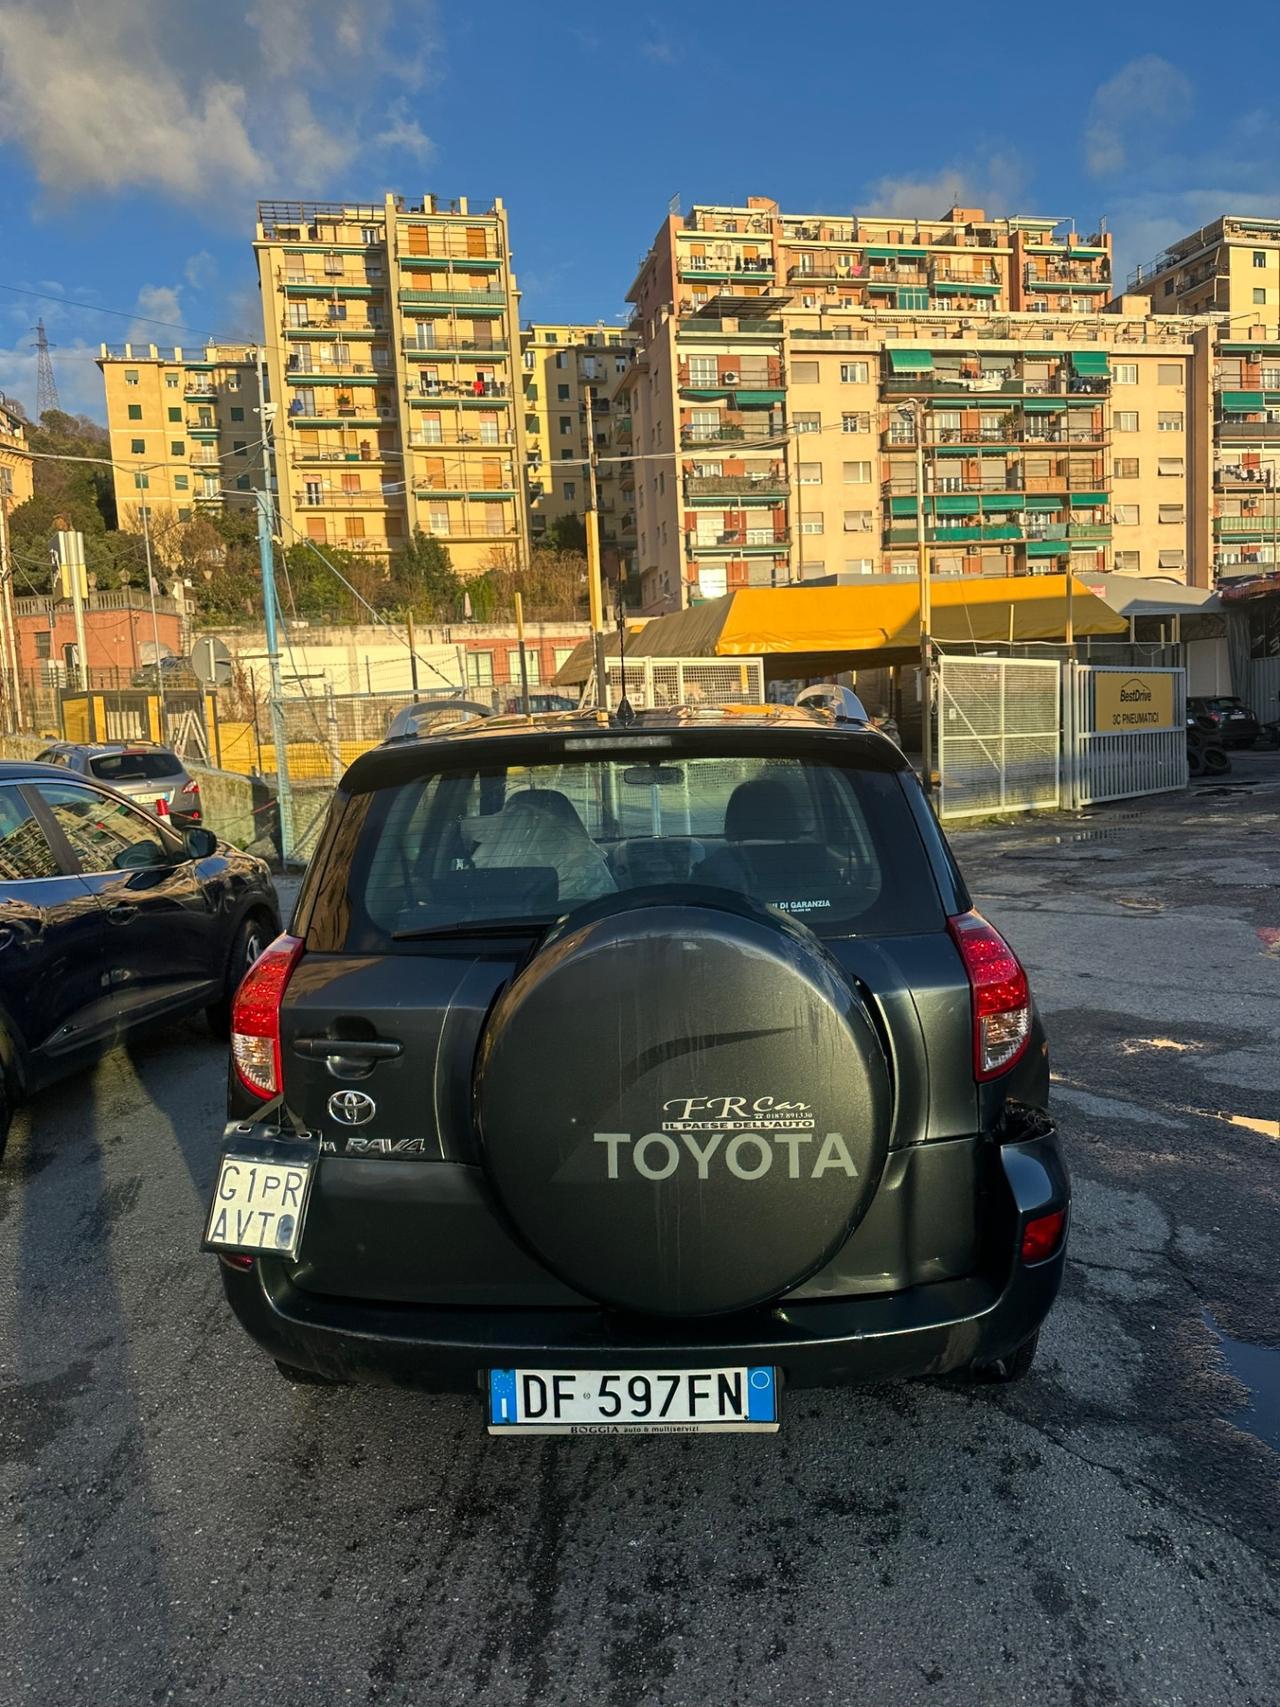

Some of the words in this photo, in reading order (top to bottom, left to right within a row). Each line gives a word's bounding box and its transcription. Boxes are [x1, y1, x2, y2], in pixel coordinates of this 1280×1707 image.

[1120, 689, 1152, 702] BestDrive
[1122, 712, 1160, 724] PNEUMATICI
[790, 900, 831, 909] GARANZIA
[752, 1096, 811, 1112] Car
[682, 1122, 729, 1130] PAESE
[733, 1121, 813, 1129] DELL'AUTO
[345, 1138, 426, 1153] RAV4
[593, 1132, 859, 1181] TOYOTA
[570, 1426, 619, 1434] BOGGIA
